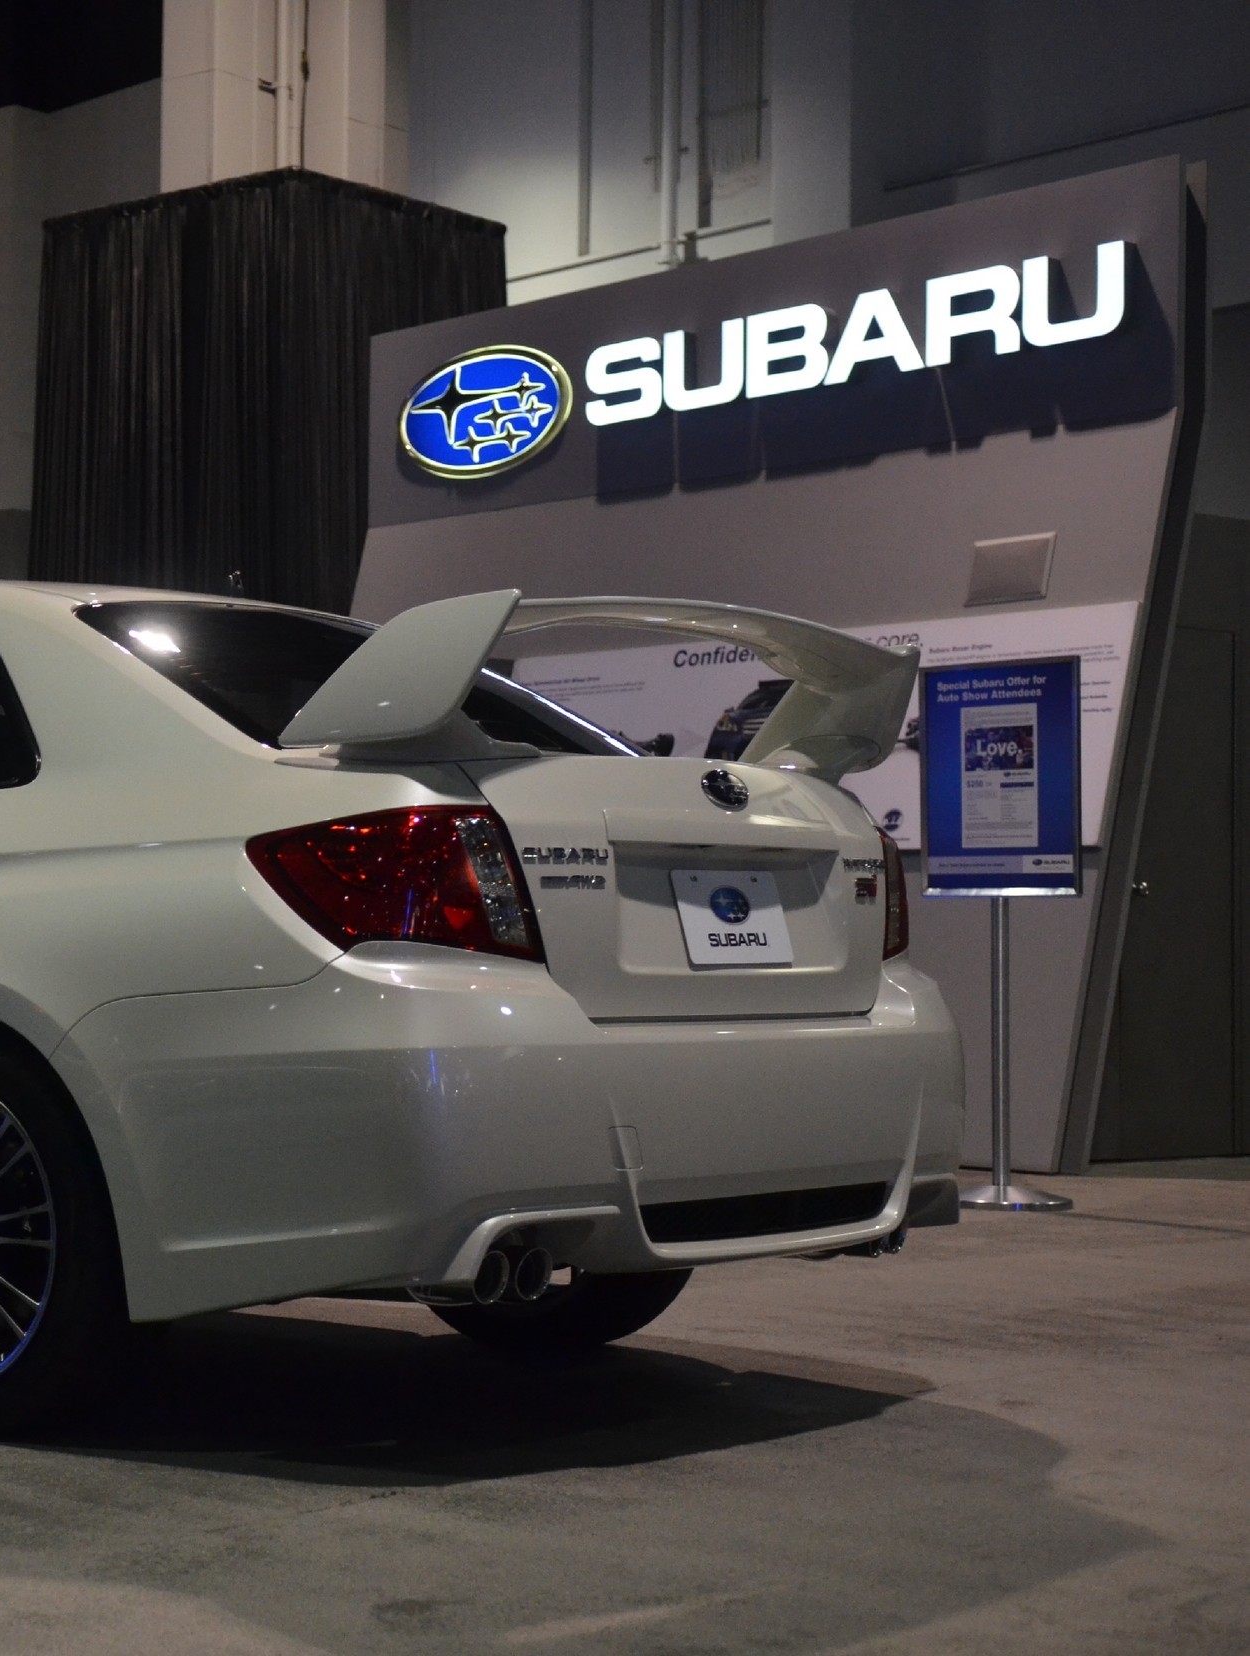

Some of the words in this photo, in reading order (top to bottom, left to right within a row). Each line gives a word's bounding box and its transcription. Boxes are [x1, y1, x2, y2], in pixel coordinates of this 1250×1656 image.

[585, 240, 1127, 426] SUBARU
[673, 646, 755, 667] Confide
[937, 680, 969, 692] Special
[972, 679, 1004, 689] Subaru
[1007, 676, 1030, 686] Offer
[1033, 675, 1046, 684] for
[937, 693, 959, 703] Auto
[962, 691, 988, 701] Show
[991, 688, 1042, 698] Attendees
[976, 739, 1023, 757] Love.
[522, 847, 608, 861] SUBARU
[708, 933, 768, 947] SUBARU
